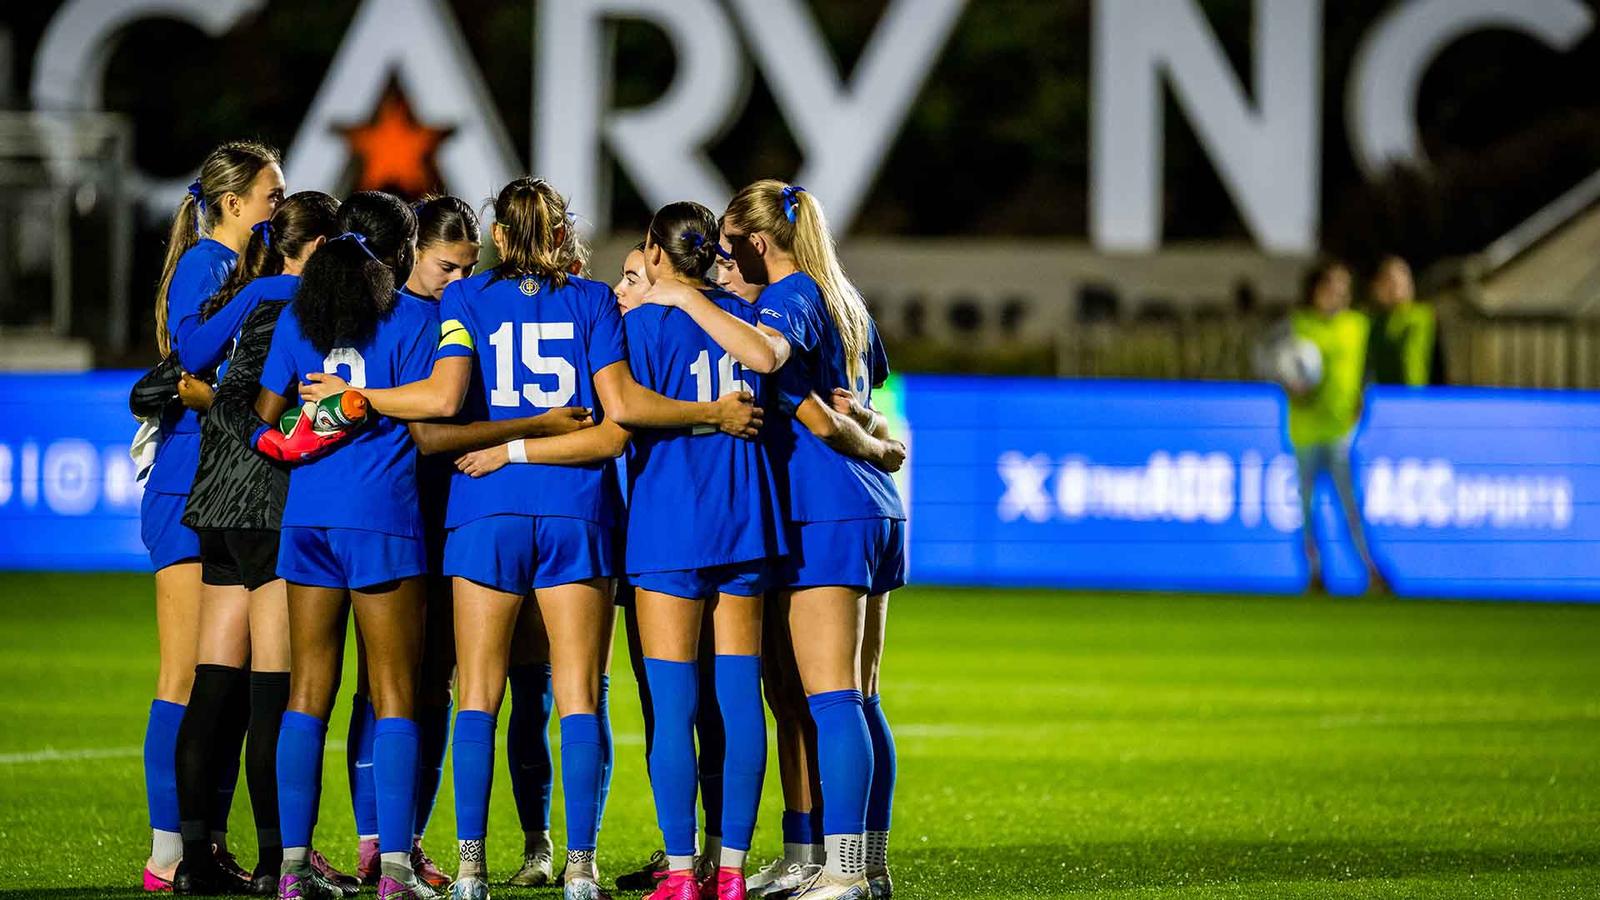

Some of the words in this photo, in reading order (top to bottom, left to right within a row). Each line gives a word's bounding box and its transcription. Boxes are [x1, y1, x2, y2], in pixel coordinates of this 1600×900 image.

[30, 0, 968, 236] CARY
[1090, 0, 1592, 255] NC
[489, 321, 576, 408] 15
